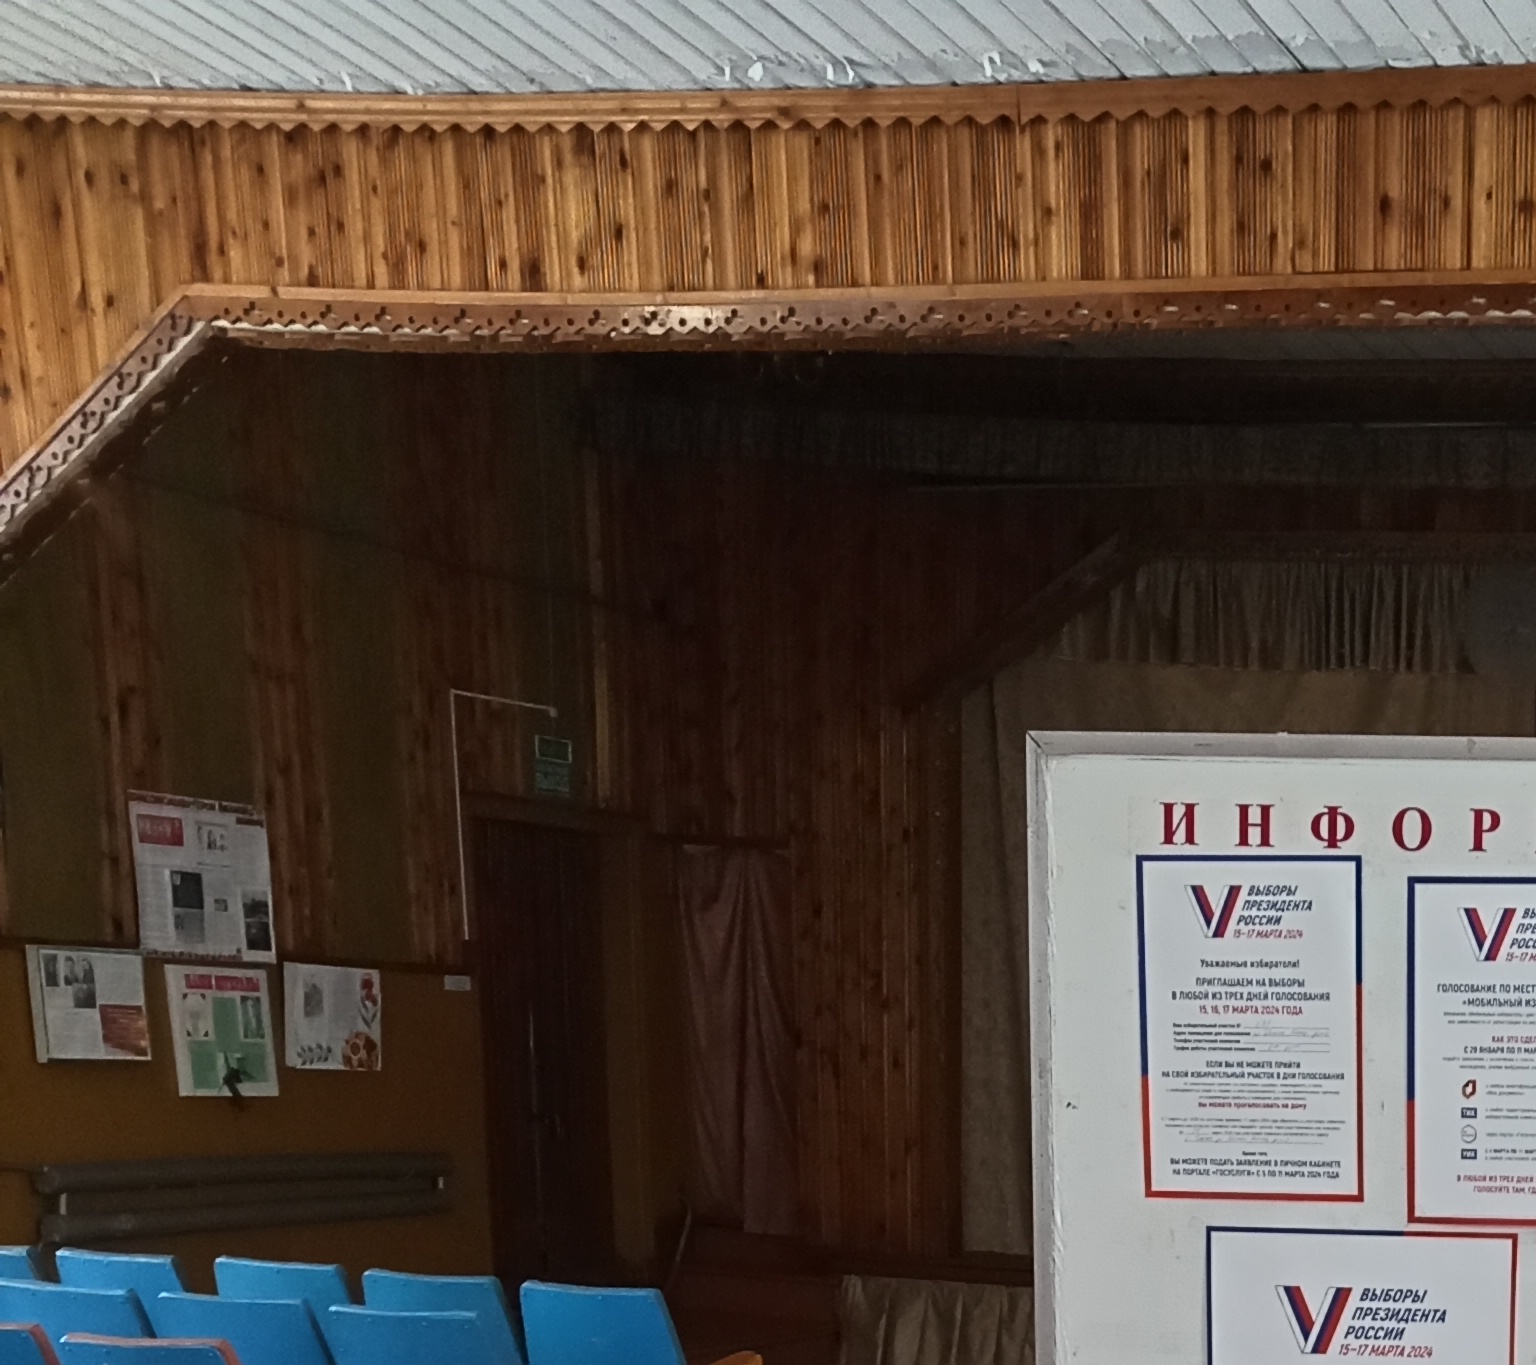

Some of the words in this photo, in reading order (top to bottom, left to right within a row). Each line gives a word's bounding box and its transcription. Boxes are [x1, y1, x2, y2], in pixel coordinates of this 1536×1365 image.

[1247, 885, 1298, 897] ВЫБОРЫ
[1242, 900, 1312, 912] ПРЕЗИДЕНТА
[1237, 915, 1282, 926] РОССИИ
[1255, 930, 1282, 939] МАРТА
[1284, 930, 1303, 939] 2024
[1196, 977, 1253, 987] ПРИГЛАШАЕМ
[1255, 978, 1266, 987] НА
[1268, 978, 1305, 987] ВЫБОРЫ
[1437, 984, 1497, 994] ГОЛОСОВАНИЕ
[1499, 984, 1511, 994] ПО
[1171, 991, 1177, 1000] В
[1179, 990, 1209, 1000] ЛЮБОЙ
[1211, 991, 1223, 1000] ИЗ
[1224, 992, 1244, 1001] ТРЕХ
[1246, 991, 1269, 1002] ДНЕЙ
[1270, 992, 1331, 1001] ГОЛОСОВАНИЯ
[1359, 1288, 1427, 1303] ВЫБОРЫ
[1351, 1307, 1447, 1324] ПРЕЗИДЕНТА
[1344, 1326, 1406, 1341] РОССИИ
[1369, 1345, 1405, 1358] МАРТА
[1407, 1346, 1433, 1358] 2024
